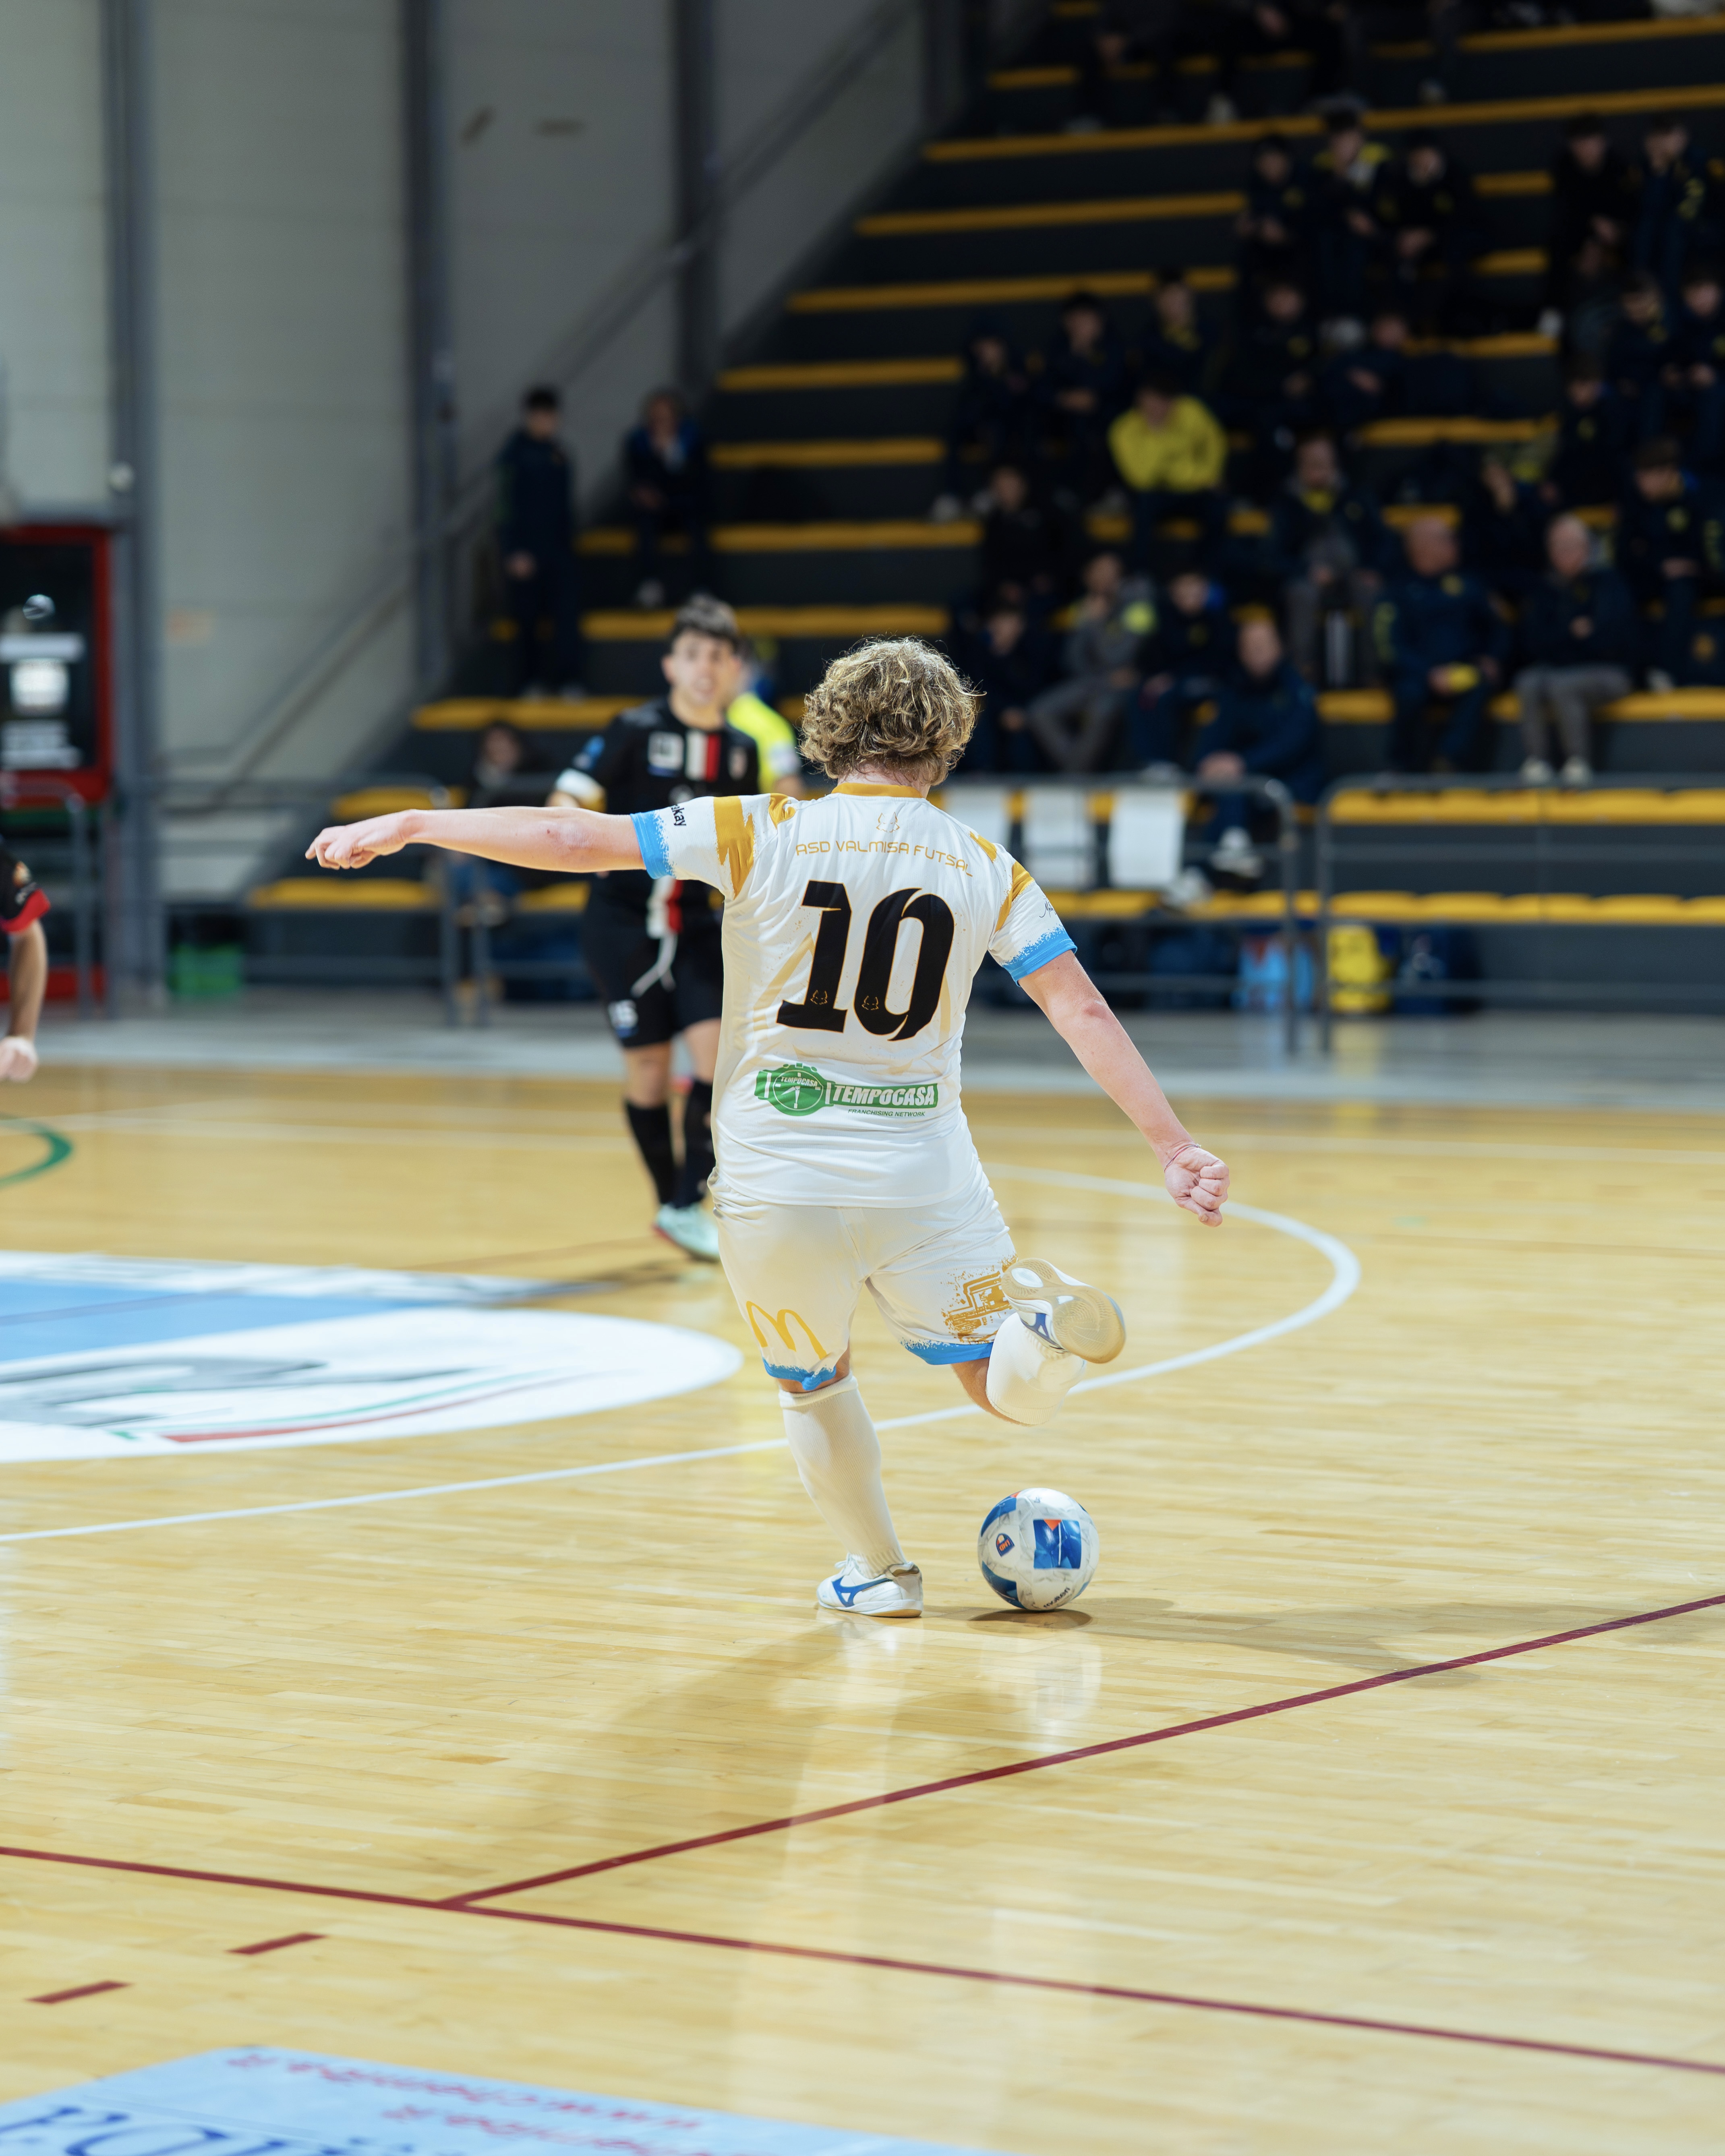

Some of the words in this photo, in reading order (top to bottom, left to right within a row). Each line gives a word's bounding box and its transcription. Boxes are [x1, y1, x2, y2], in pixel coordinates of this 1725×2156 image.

[795, 841, 830, 856] ASD
[836, 840, 909, 854] VALMISA
[913, 845, 973, 877] FUTSAL
[776, 879, 955, 1042] 10
[781, 1076, 818, 1087] TEMPOCASA
[832, 1085, 934, 1106] TEMPOCASA
